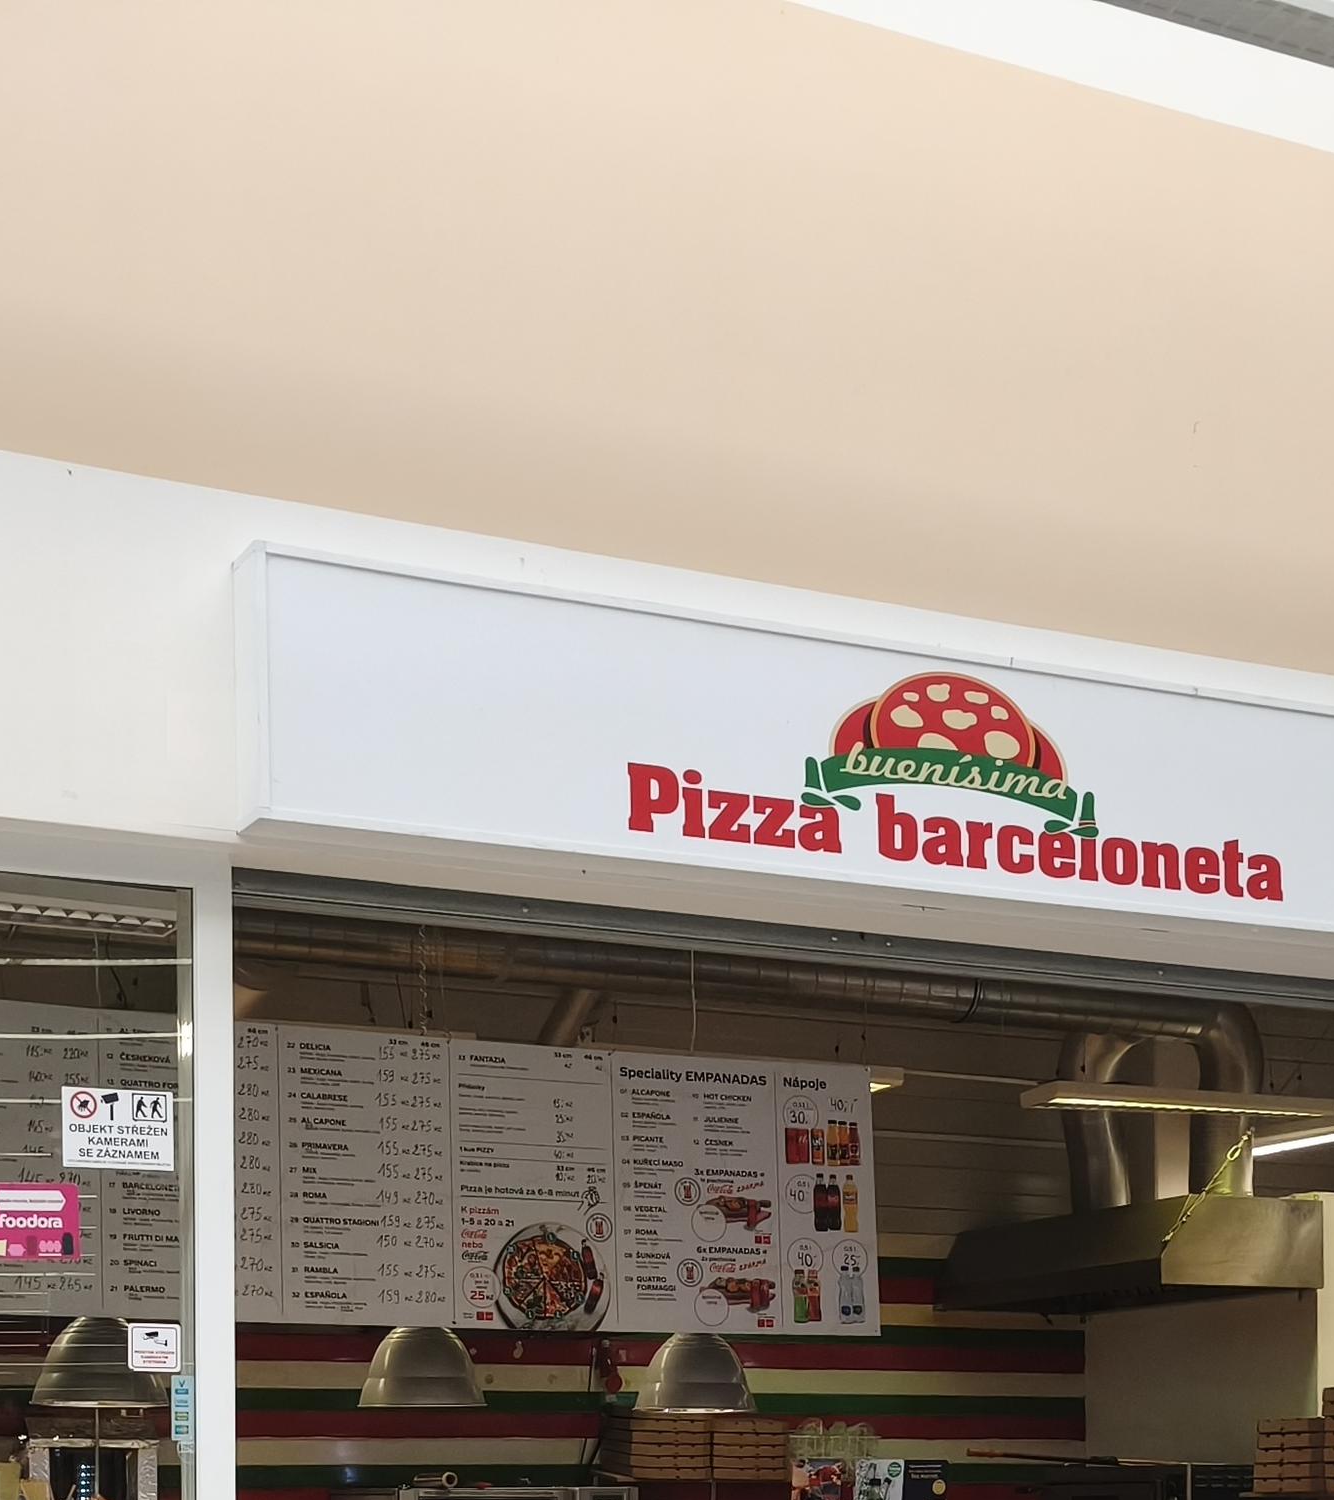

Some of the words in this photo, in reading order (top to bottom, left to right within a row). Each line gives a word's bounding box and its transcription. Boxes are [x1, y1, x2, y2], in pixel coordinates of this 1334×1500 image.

[841, 741, 1068, 800] buenísima
[627, 762, 842, 854] Pizza
[875, 792, 1284, 902] barceloneta
[299, 1043, 331, 1051] DELICIA
[300, 1067, 342, 1076] MEXICANA
[620, 1067, 682, 1082] Speciality
[685, 1071, 766, 1086] EMPANADAS
[783, 1077, 827, 1091] Nápoje
[301, 1092, 348, 1101] CALABRESE
[69, 1124, 113, 1134] OBJEKT
[117, 1125, 168, 1136] STŘEŽEN
[88, 1137, 149, 1147] KAMERAMI
[79, 1148, 94, 1157] SE
[96, 1148, 159, 1160] ZÁZNAMEM
[469, 1206, 499, 1215] pizzám
[0, 1214, 63, 1229] foodora
[303, 1217, 340, 1225] QUATTRO
[343, 1218, 379, 1227] STAGIONI
[303, 1241, 339, 1249] SALSICIA
